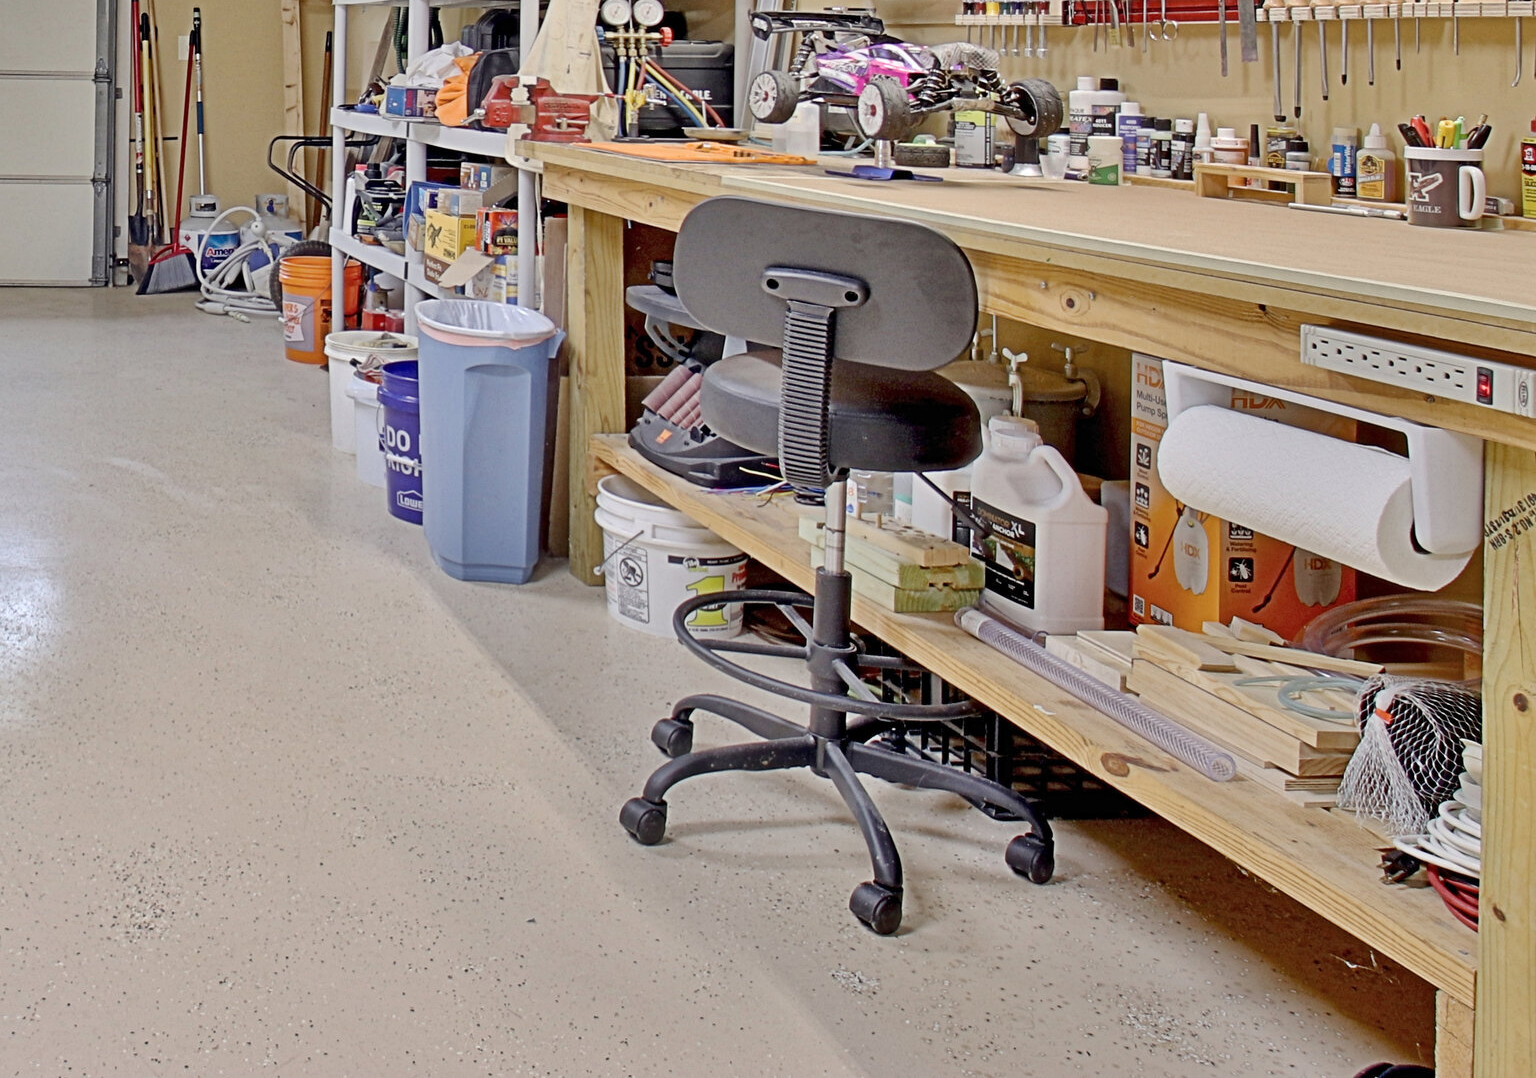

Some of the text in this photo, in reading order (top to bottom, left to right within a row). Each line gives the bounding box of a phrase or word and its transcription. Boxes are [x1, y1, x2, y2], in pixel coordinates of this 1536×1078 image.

[1412, 204, 1442, 214] EAGLE
[1136, 402, 1156, 417] Pump
[386, 425, 411, 452] DO
[399, 494, 423, 509] LOWE
[1010, 520, 1025, 538] XL
[1180, 541, 1201, 560] HDX
[686, 575, 728, 627] 1
